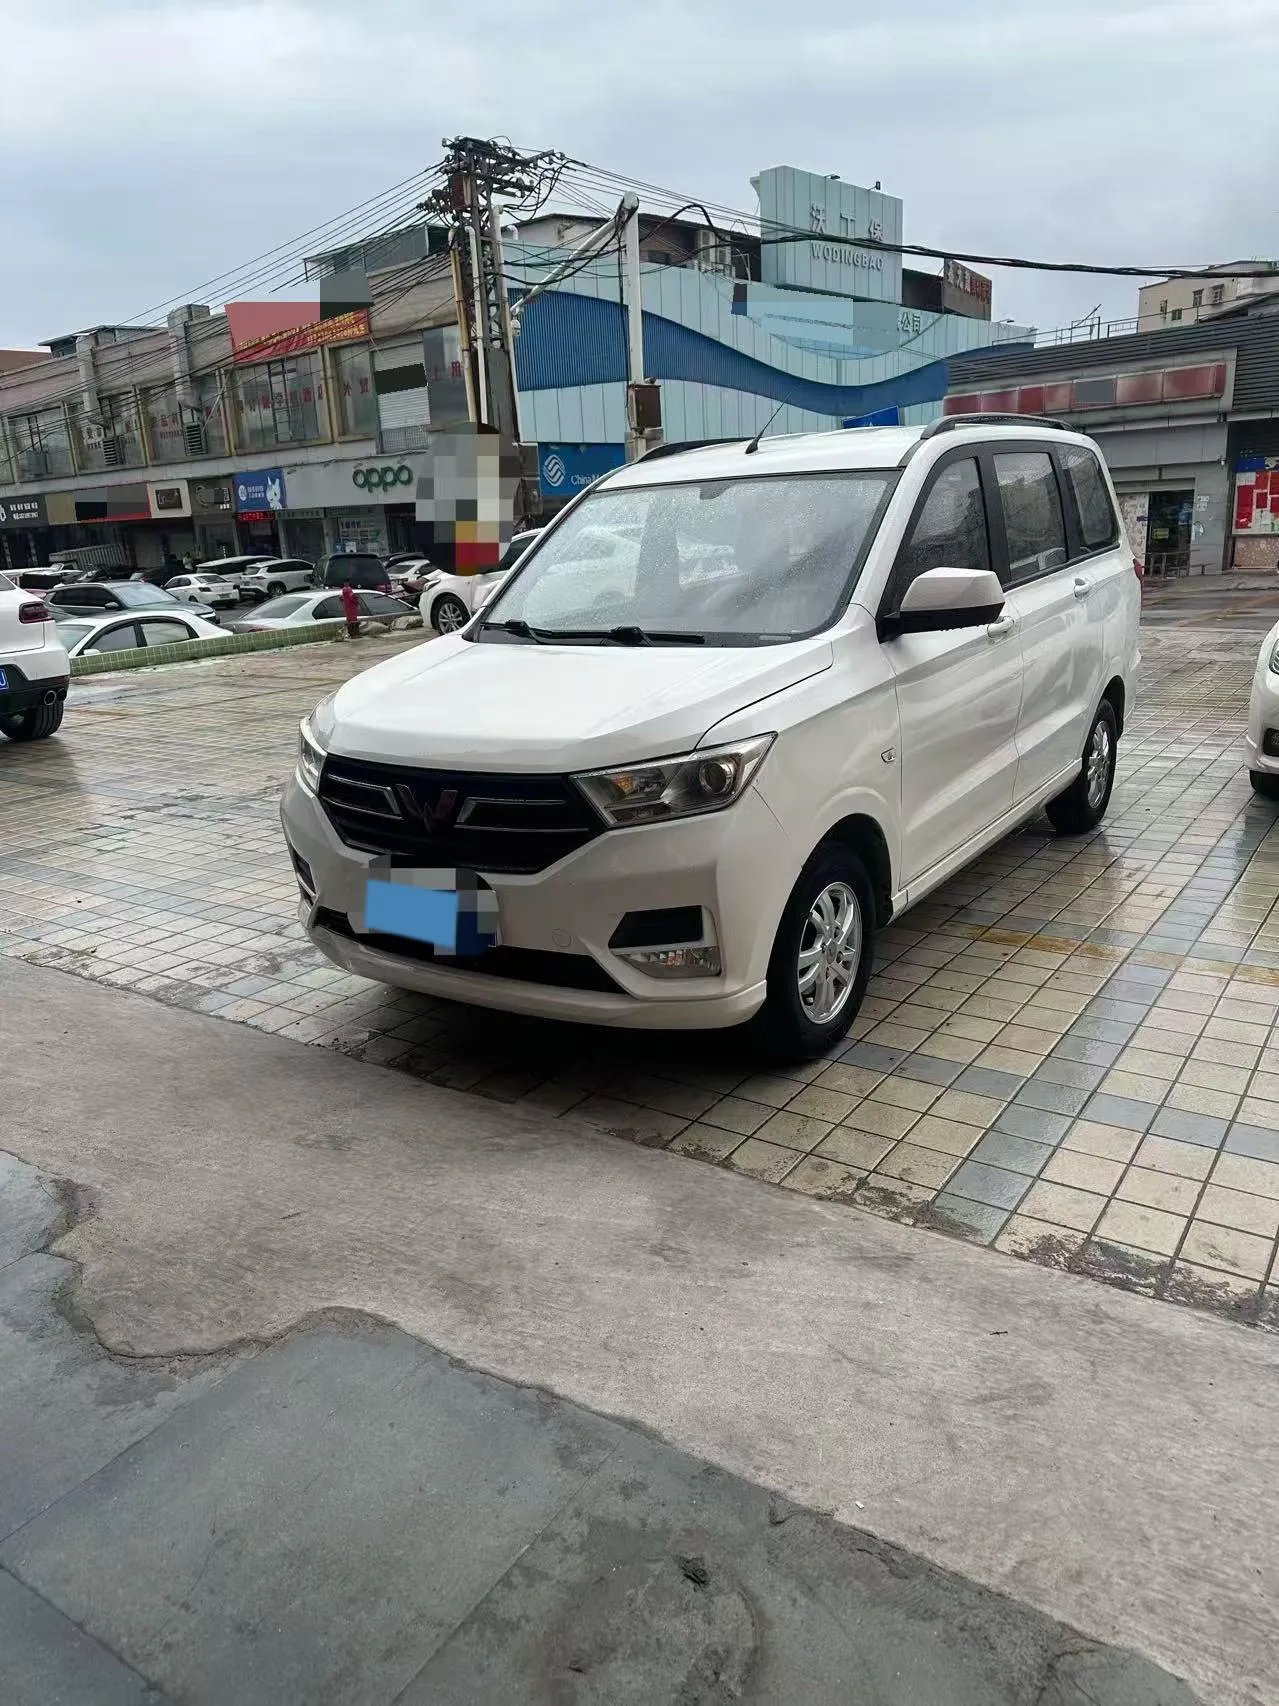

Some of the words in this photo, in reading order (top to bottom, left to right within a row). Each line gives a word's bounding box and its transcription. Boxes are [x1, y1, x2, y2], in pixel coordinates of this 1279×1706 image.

[811, 242, 885, 271] WODINGBAO
[897, 311, 921, 335] 公司
[570, 474, 592, 485] China
